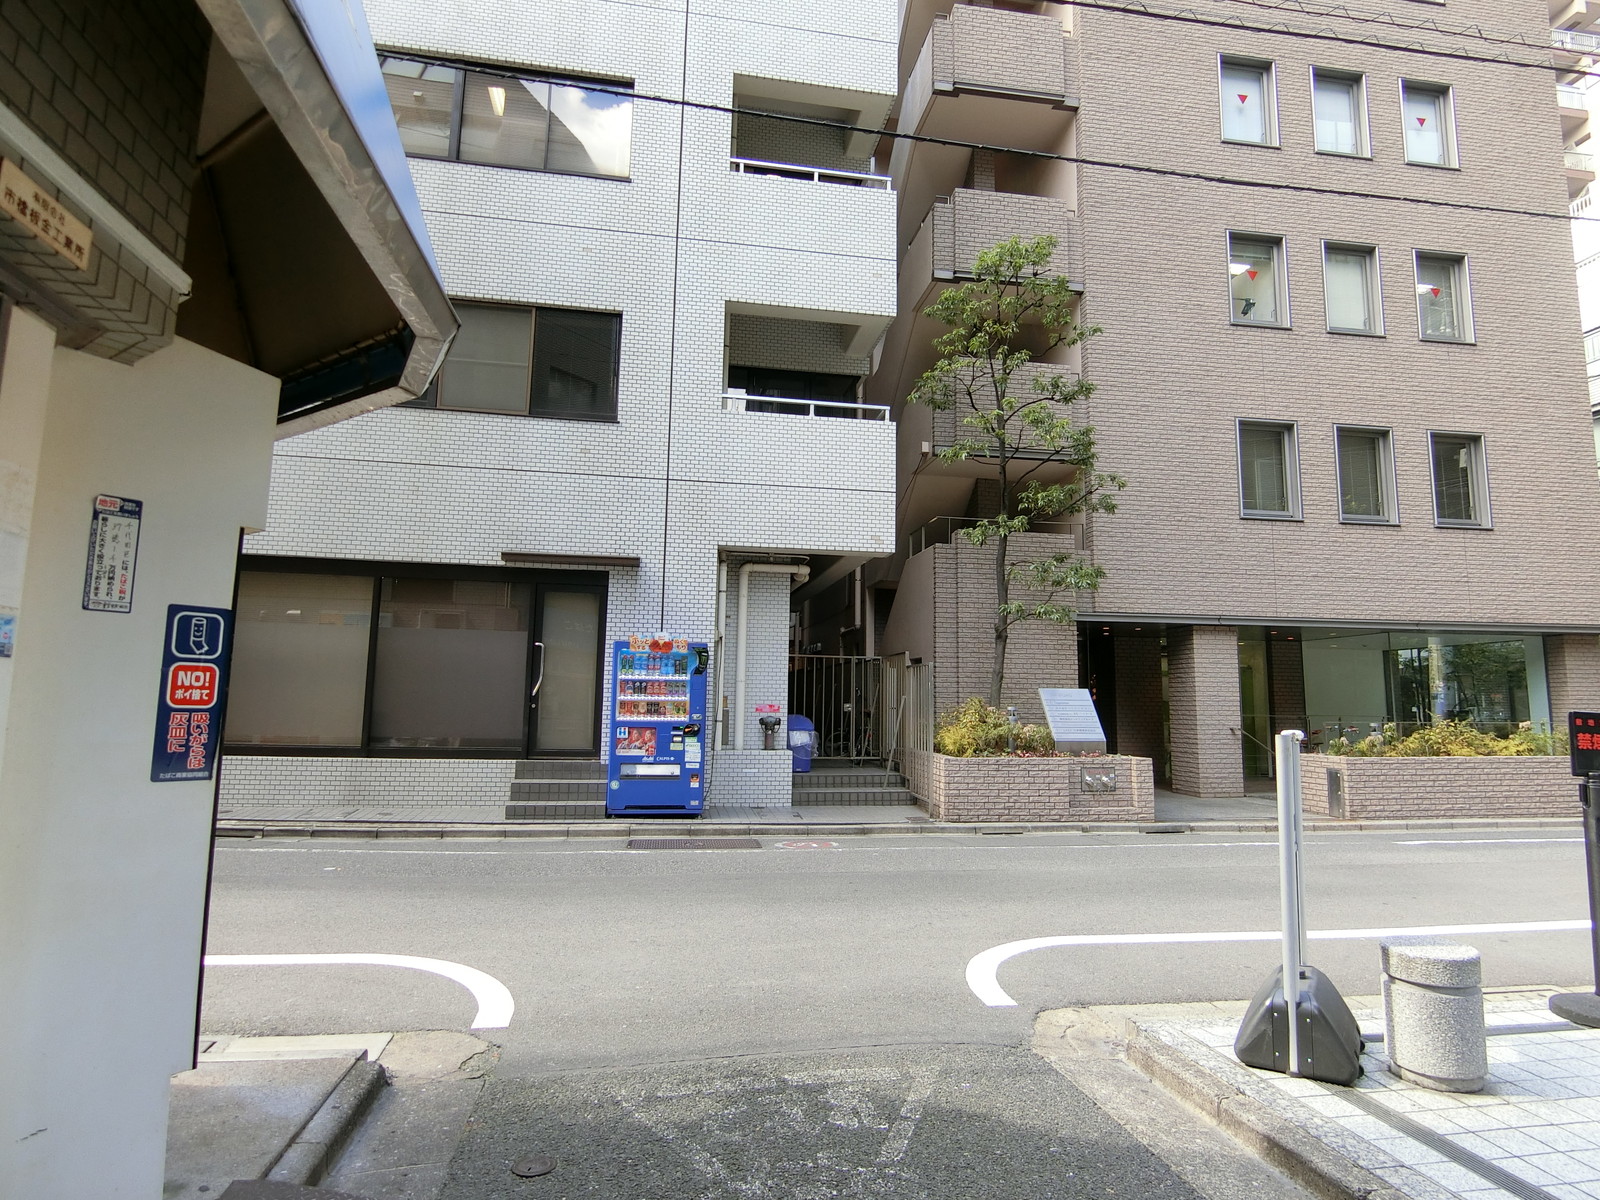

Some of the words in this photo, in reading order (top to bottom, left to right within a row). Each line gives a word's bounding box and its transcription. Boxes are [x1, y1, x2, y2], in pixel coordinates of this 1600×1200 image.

[98, 498, 119, 509] 地元
[177, 671, 211, 687] NO!
[175, 688, 210, 700] ポイ捨て
[167, 712, 190, 753] 灰皿に
[187, 712, 210, 769] 吸いがらは
